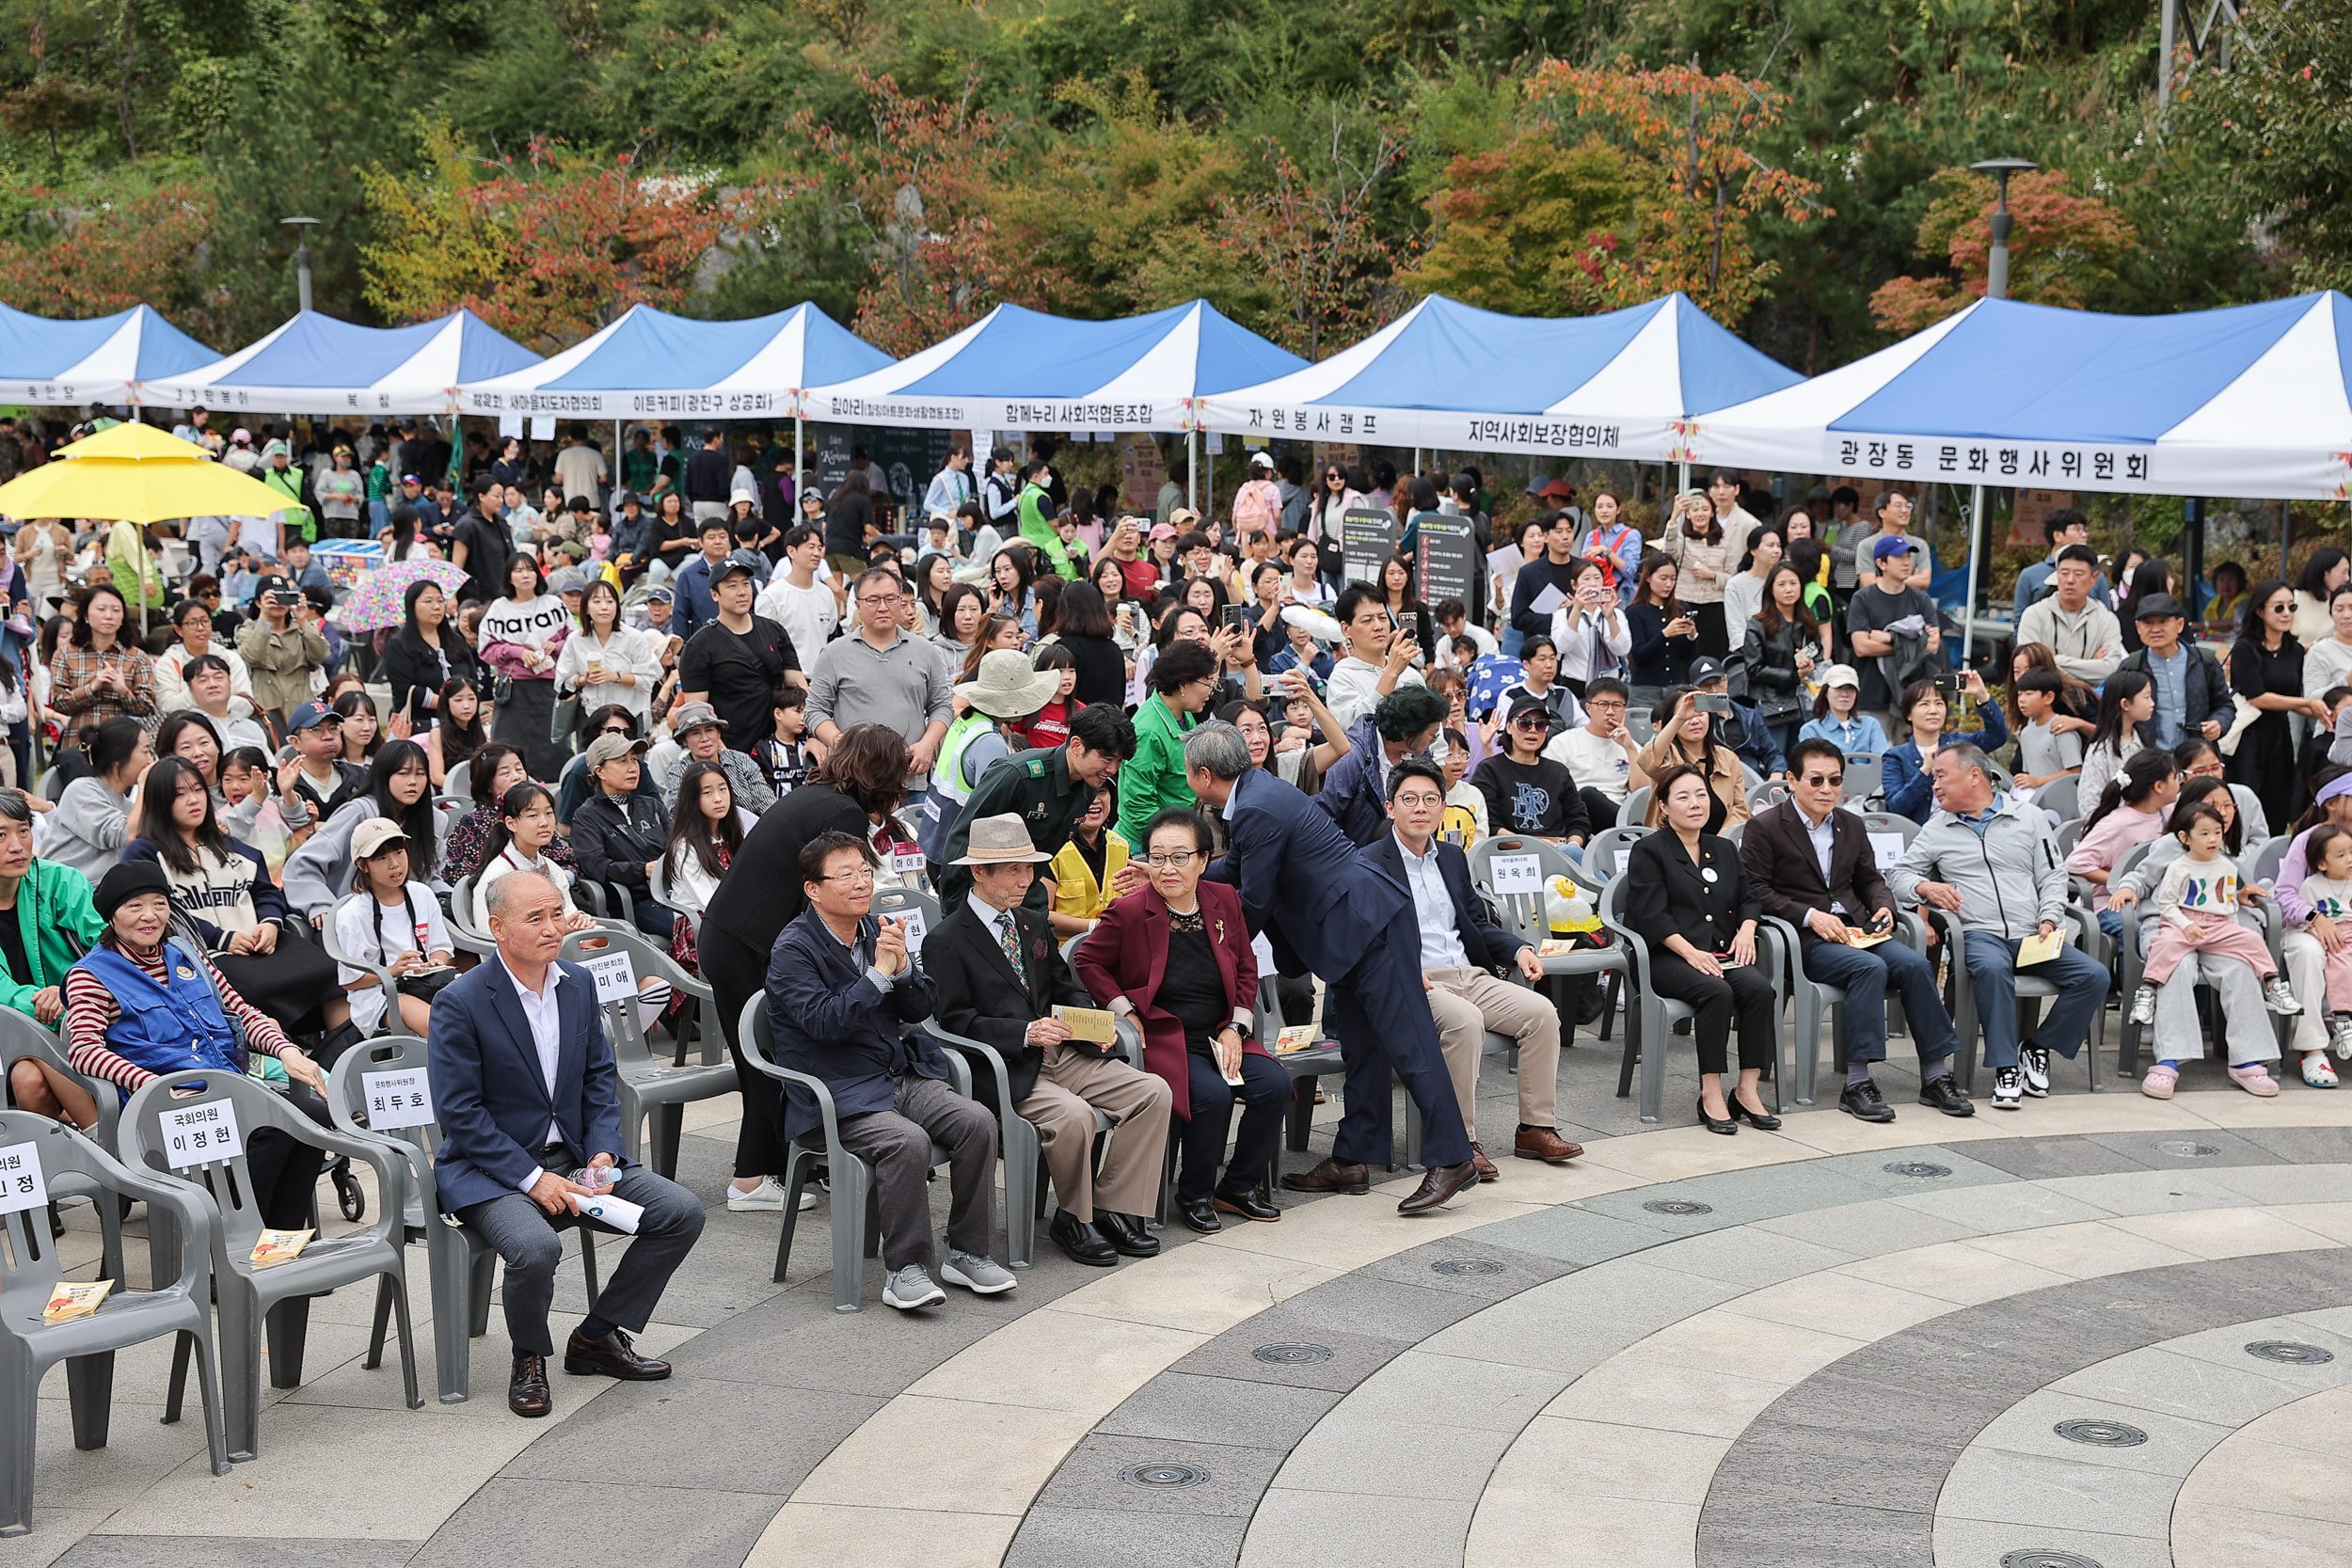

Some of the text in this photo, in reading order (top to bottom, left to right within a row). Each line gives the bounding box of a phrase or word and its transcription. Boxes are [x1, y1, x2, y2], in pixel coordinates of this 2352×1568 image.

[510, 394, 602, 412] 새마을지도자협의회
[634, 394, 774, 413] 이든커피(광진구 상공회)
[1006, 404, 1153, 425] 함께누리 사회적협동조합
[1468, 420, 1620, 450] 지역사회보장협의체
[487, 603, 568, 634] marant
[375, 1077, 416, 1089] 문화행사위원장
[174, 1107, 218, 1127] 국회의원
